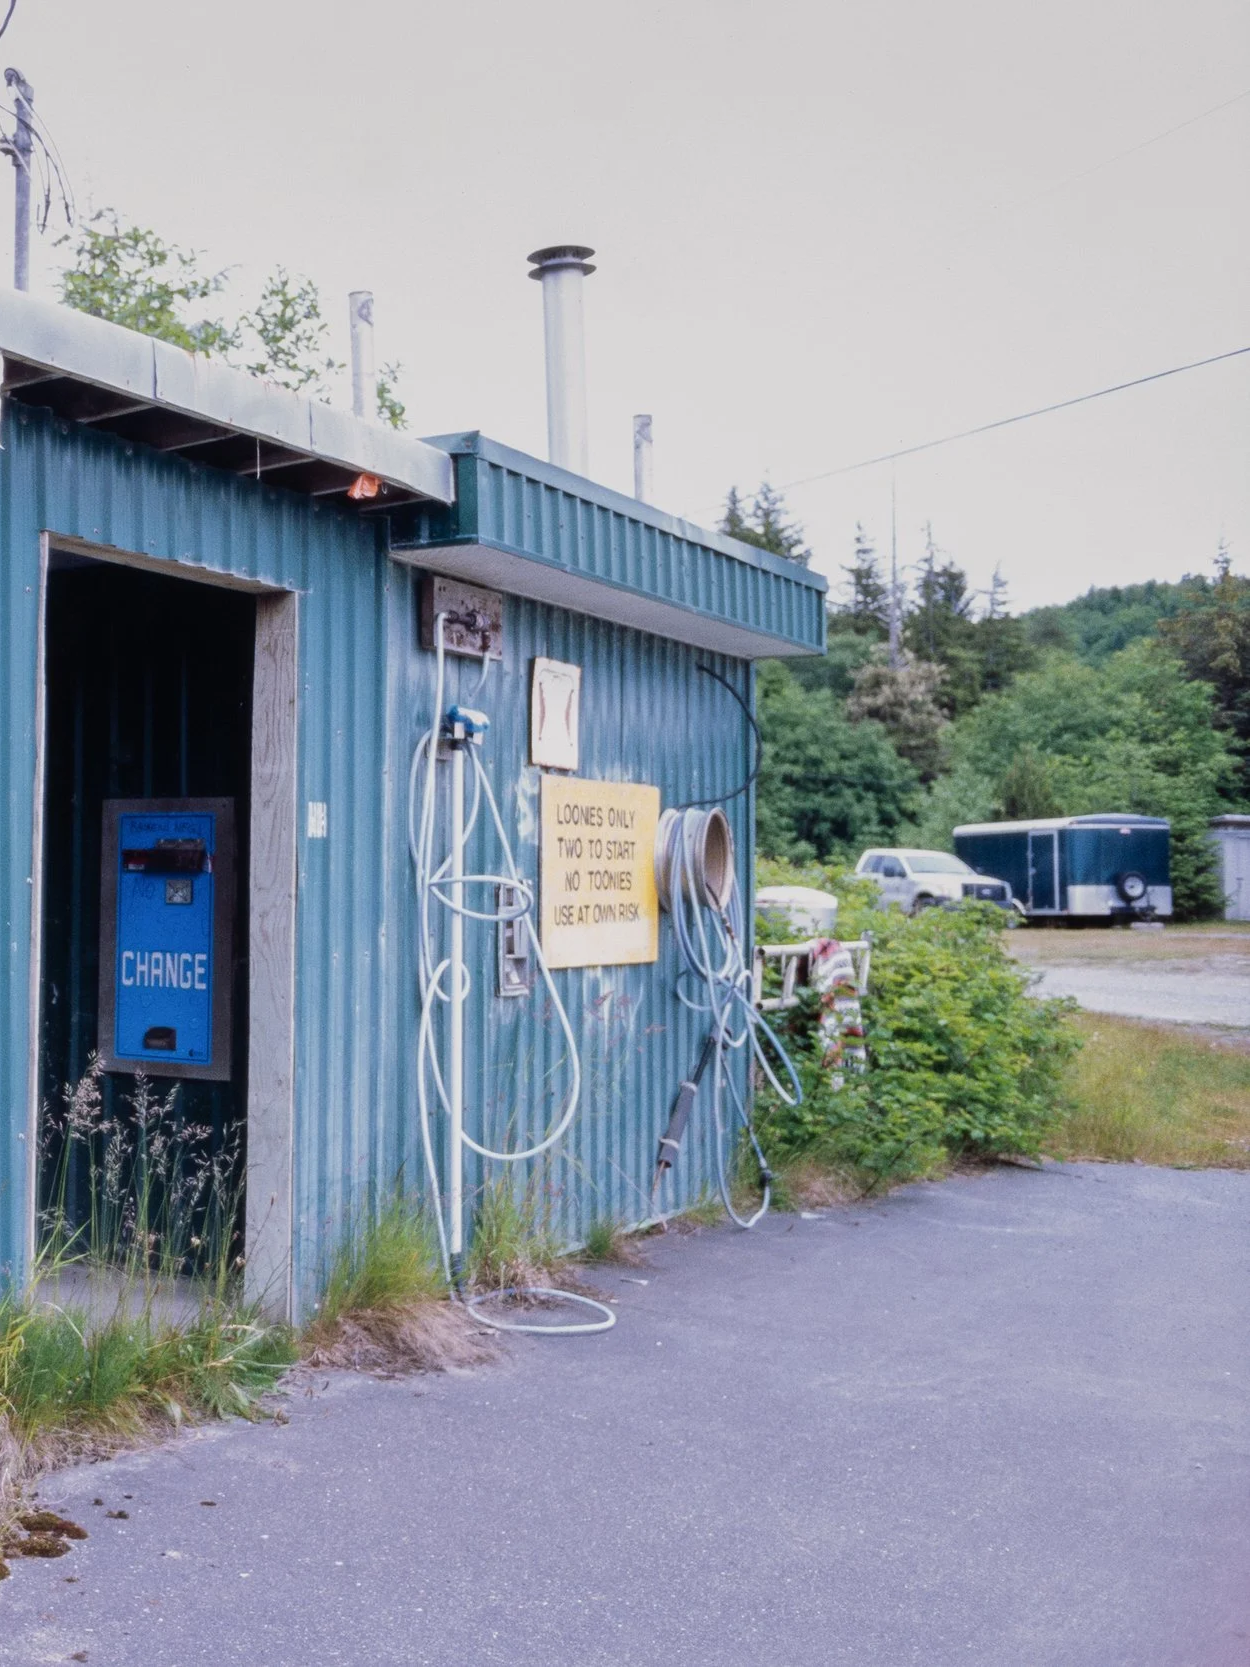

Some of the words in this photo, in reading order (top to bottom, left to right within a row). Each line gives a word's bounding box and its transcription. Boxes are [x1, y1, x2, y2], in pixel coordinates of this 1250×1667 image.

[556, 803, 603, 827] LOONIES
[608, 808, 636, 830] ONLY
[557, 837, 582, 859] TWO
[588, 838, 603, 860] TO
[606, 841, 636, 861] START
[564, 870, 581, 892] NO
[588, 870, 632, 892] TOONIES
[554, 905, 574, 927] USE
[577, 904, 590, 925] AT
[593, 903, 616, 925] OWN
[618, 903, 640, 923] RISK
[121, 950, 207, 990] CHANGE
